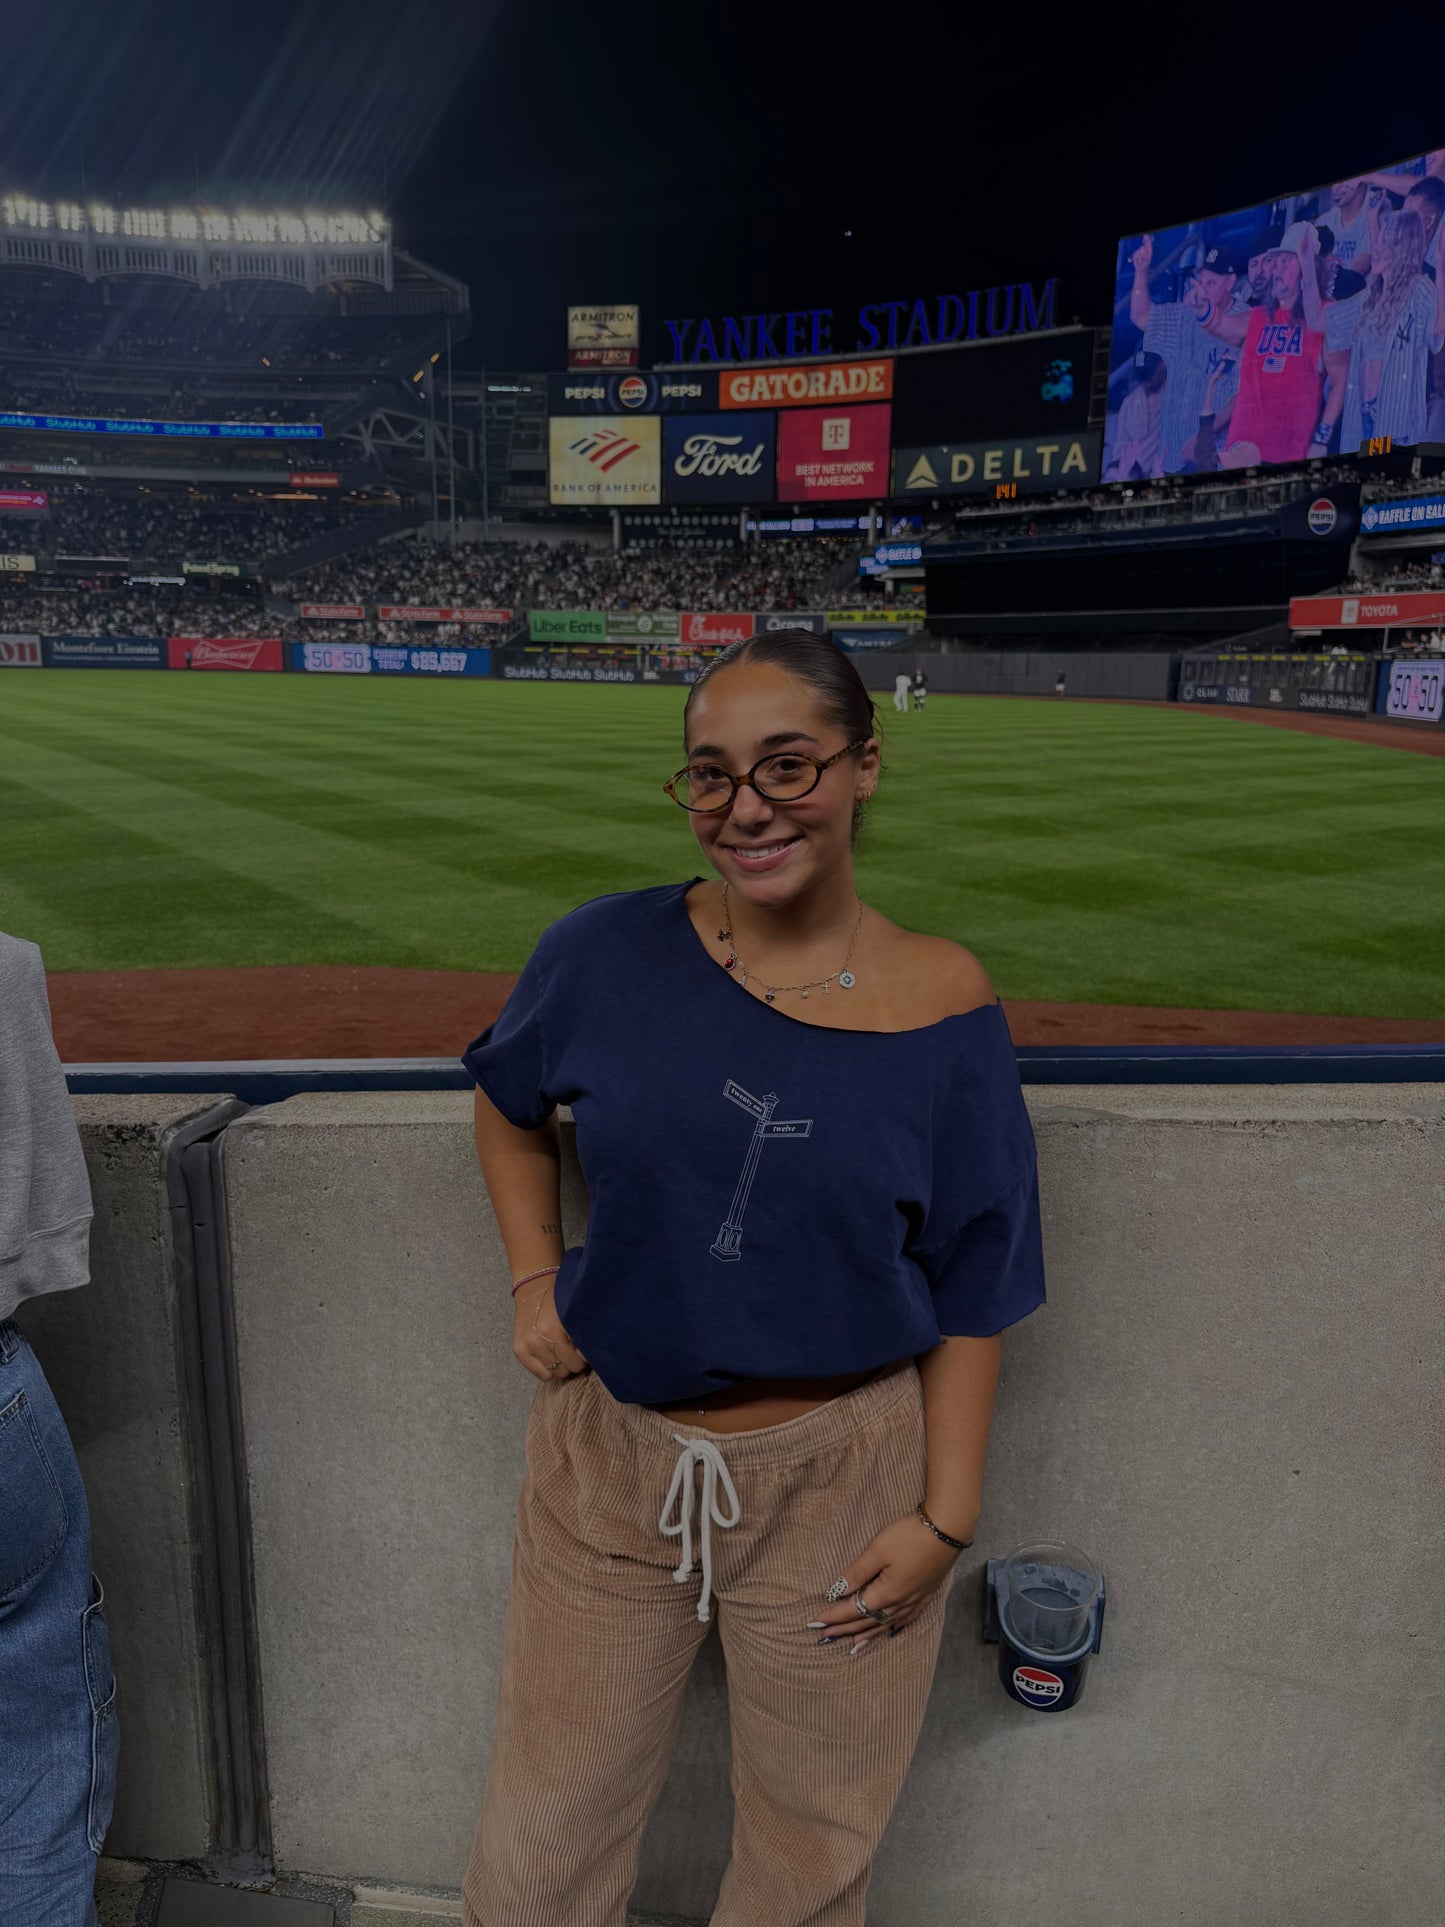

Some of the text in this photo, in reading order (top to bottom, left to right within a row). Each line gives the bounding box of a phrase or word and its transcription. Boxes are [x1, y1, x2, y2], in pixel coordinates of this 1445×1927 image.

[571, 311, 635, 322] ARMITRON
[663, 278, 1061, 363] YANKEE STADIUM
[1256, 325, 1302, 356] USA
[661, 385, 702, 398] PEPSI
[729, 365, 885, 403] GATORADE
[564, 387, 605, 400] PEPSI
[46, 418, 97, 431] StubHub
[105, 421, 154, 433] StubHub
[163, 424, 210, 435] StubHub
[218, 426, 265, 436] StubHub
[273, 427, 318, 437] StubHub
[674, 434, 765, 477] Ford
[950, 442, 1088, 483] DELTA
[795, 462, 874, 476] BEST NETWORK
[553, 484, 657, 493] BANK OF AMERICA
[804, 475, 864, 487] IN AMERICA
[1378, 508, 1411, 524] RAFFLE
[1412, 506, 1425, 521] ON
[1361, 604, 1398, 617] TOYOTA
[533, 619, 567, 633] Uber
[570, 619, 602, 634] Eats
[52, 641, 160, 655] Montefiore Einstein
[504, 666, 548, 678] StubHub
[550, 668, 592, 680] StubHub
[594, 670, 634, 682] StubHub
[731, 1087, 753, 1107] twenty
[772, 1124, 797, 1133] twelve
[1015, 1675, 1061, 1694] PEPSI
